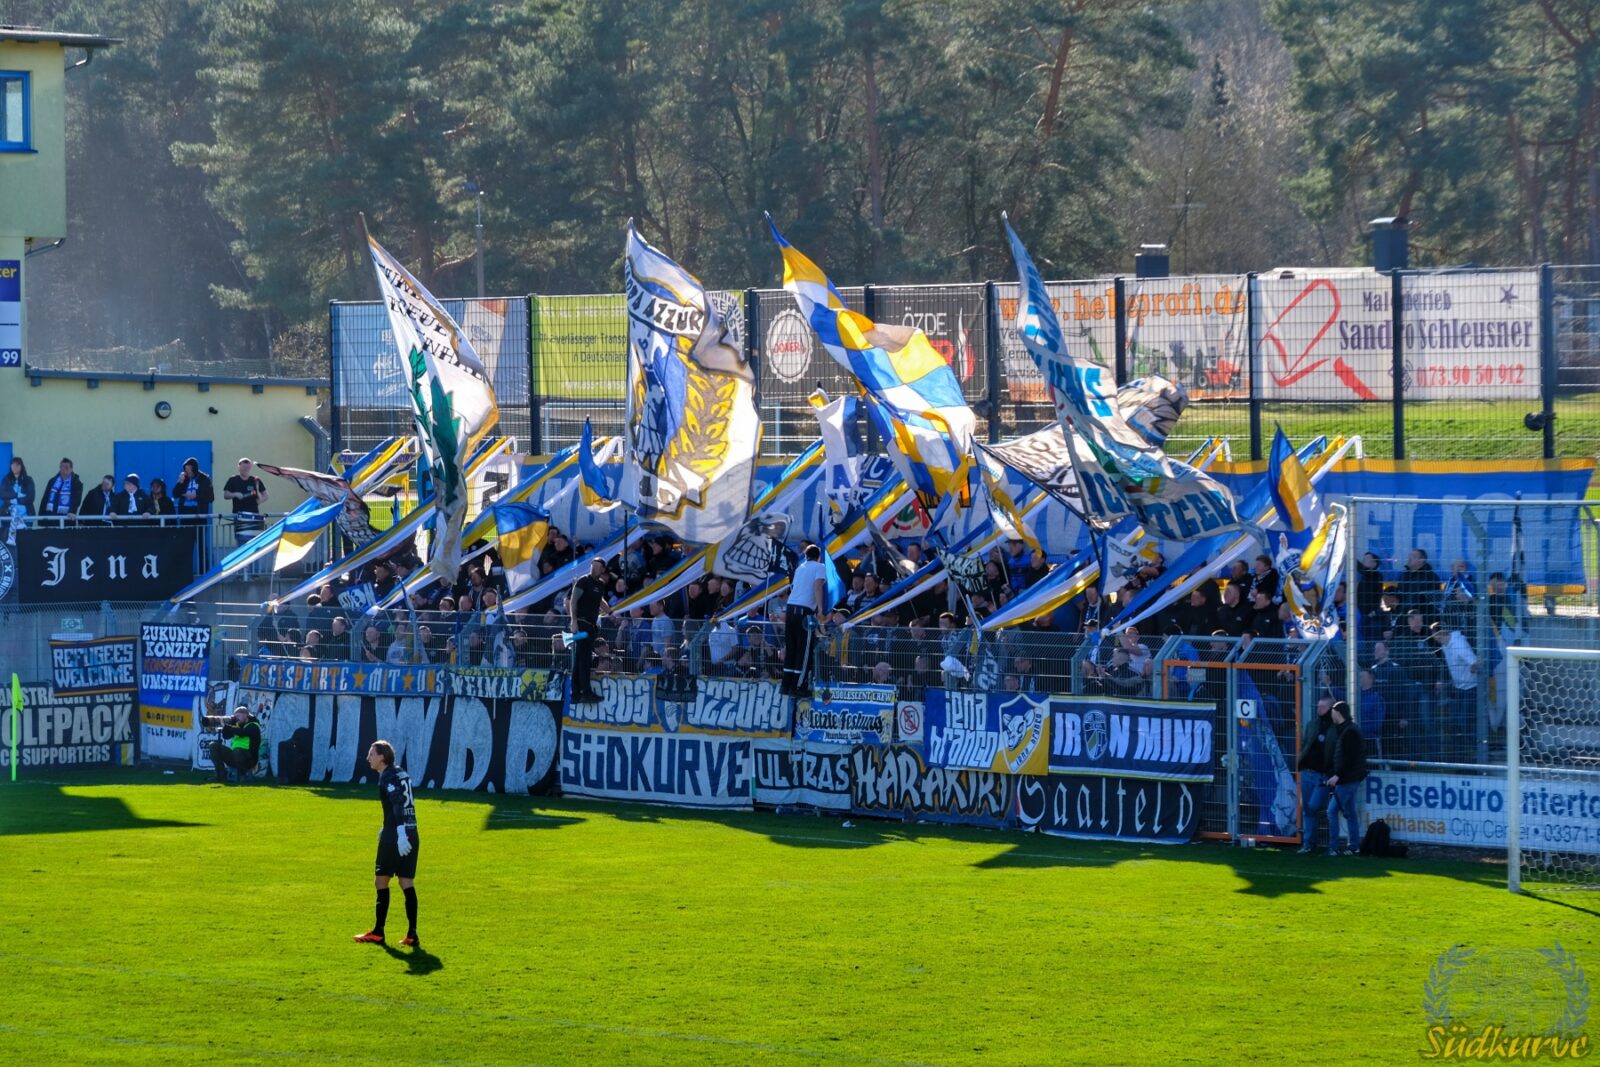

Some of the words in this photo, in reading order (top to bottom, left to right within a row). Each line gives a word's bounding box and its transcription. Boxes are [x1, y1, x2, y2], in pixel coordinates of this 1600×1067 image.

[1363, 289, 1451, 313] Malbetrieb
[1339, 319, 1414, 351] Sando
[1419, 319, 1533, 349] Schleusner
[2, 351, 19, 365] 99
[40, 545, 160, 588] Jena
[142, 625, 210, 642] ZUKUNFTS
[53, 643, 134, 668] REFUGEES
[145, 641, 207, 658] KONZEPT
[54, 663, 135, 688] WELCOME
[142, 673, 207, 693] UMSETZEN
[368, 663, 401, 693] MIT
[448, 672, 523, 699] WEIMAR
[1240, 699, 1251, 717] C
[0, 704, 133, 747] OLFPACK
[1133, 716, 1213, 764] MIND
[22, 744, 111, 767] SUPPORTERS
[562, 730, 751, 798] SÜDKURVE
[756, 750, 850, 792] ULTRAS
[1017, 775, 1193, 836] Saalfeld
[1366, 776, 1504, 813] Reisebüro
[1522, 786, 1600, 818] nterto
[1366, 811, 1446, 834] Lfthansa
[1451, 817, 1478, 841] City
[1483, 819, 1529, 840] Ceer
